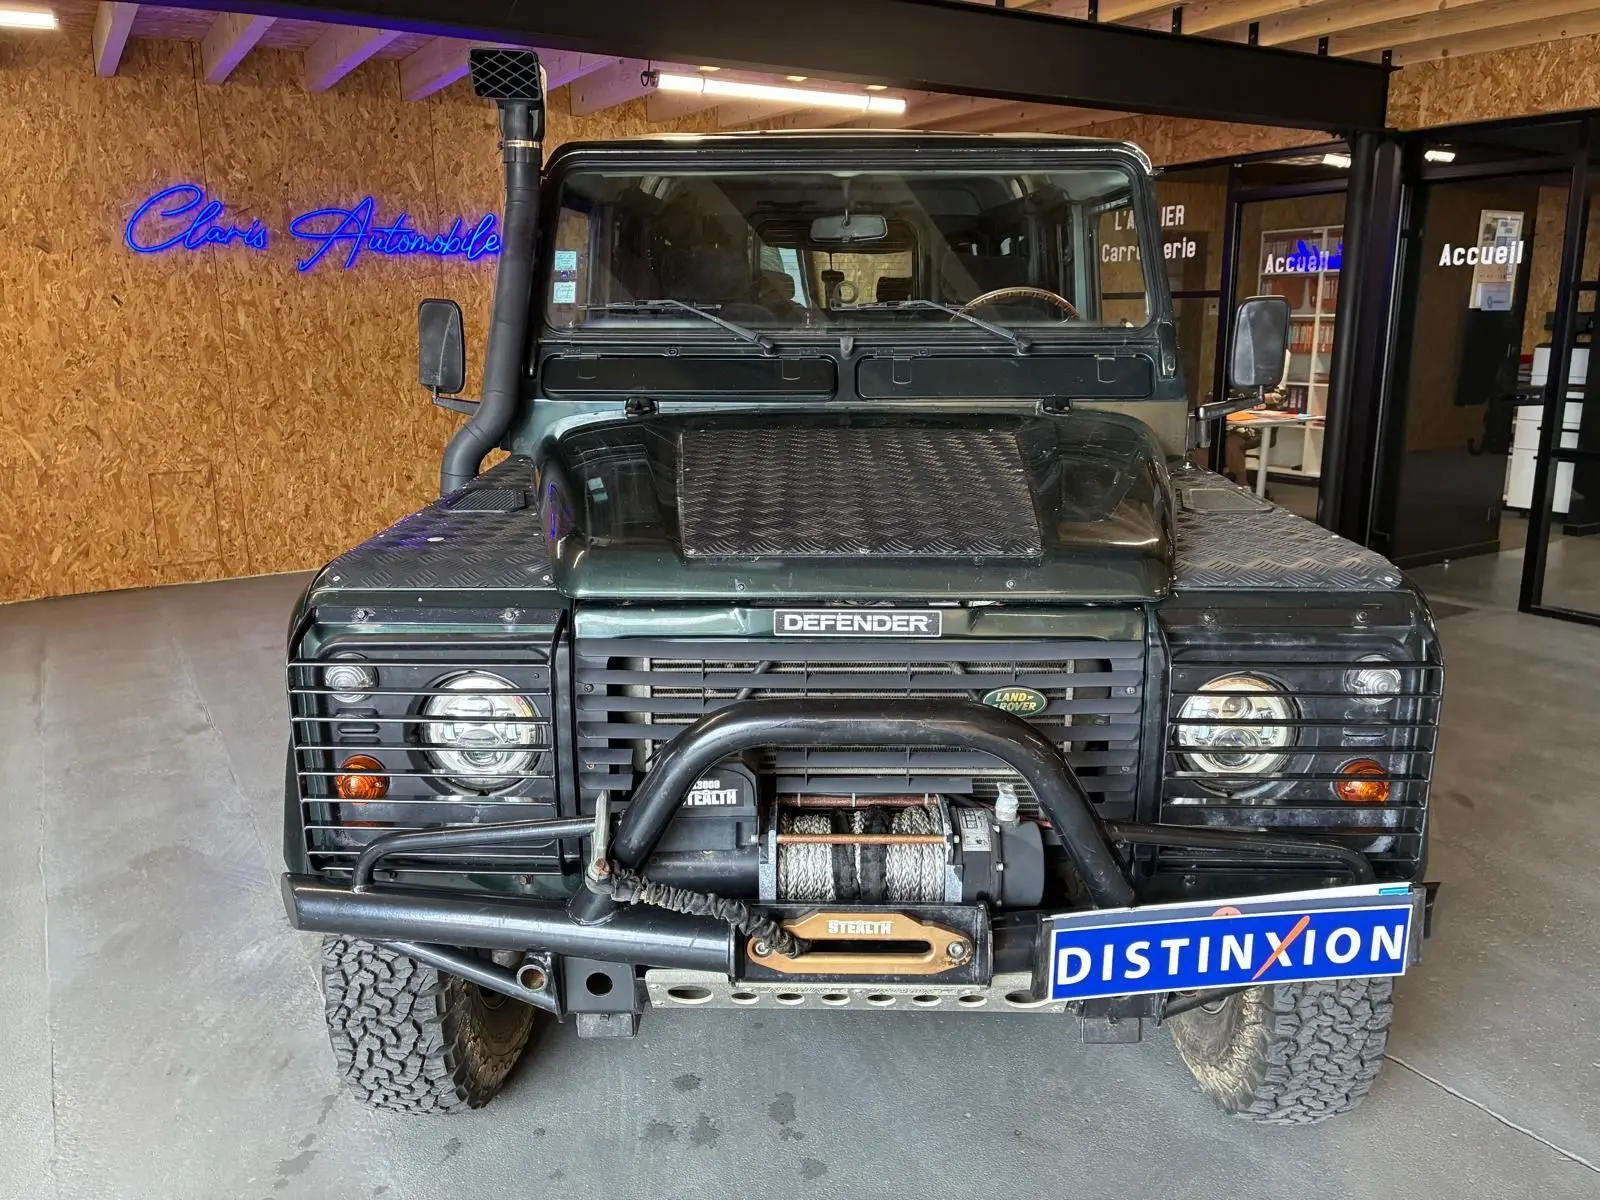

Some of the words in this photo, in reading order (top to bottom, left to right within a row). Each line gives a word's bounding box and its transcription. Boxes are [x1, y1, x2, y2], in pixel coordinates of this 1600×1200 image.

[1114, 204, 1185, 231] L'AIER
[289, 196, 501, 271] Automobile
[1265, 251, 1329, 274] Accueil
[1438, 241, 1524, 267] Accueil
[783, 613, 929, 633] DEFENDER
[995, 692, 1027, 702] LAND
[999, 702, 1037, 712] ROVER
[692, 779, 721, 791] 3000
[683, 789, 739, 806] TEALTH
[826, 919, 896, 935] STEALTH
